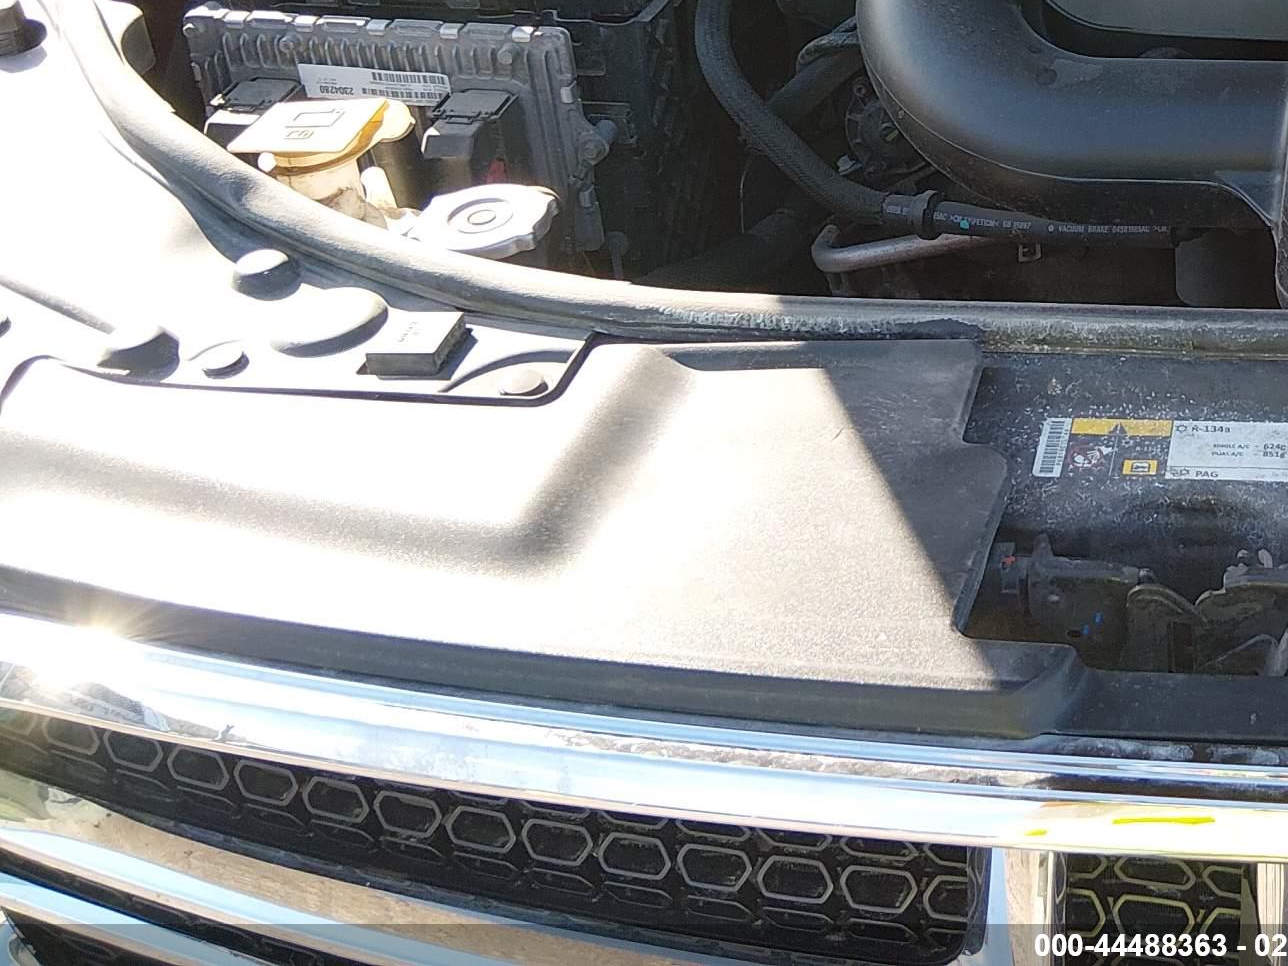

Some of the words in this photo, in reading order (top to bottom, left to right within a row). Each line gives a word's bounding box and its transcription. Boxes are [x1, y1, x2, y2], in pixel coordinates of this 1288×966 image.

[1058, 225, 1085, 233] VACUUM
[1087, 225, 1109, 233] BRAKE
[1191, 424, 1231, 434] R-134a
[1194, 470, 1220, 479] PAG
